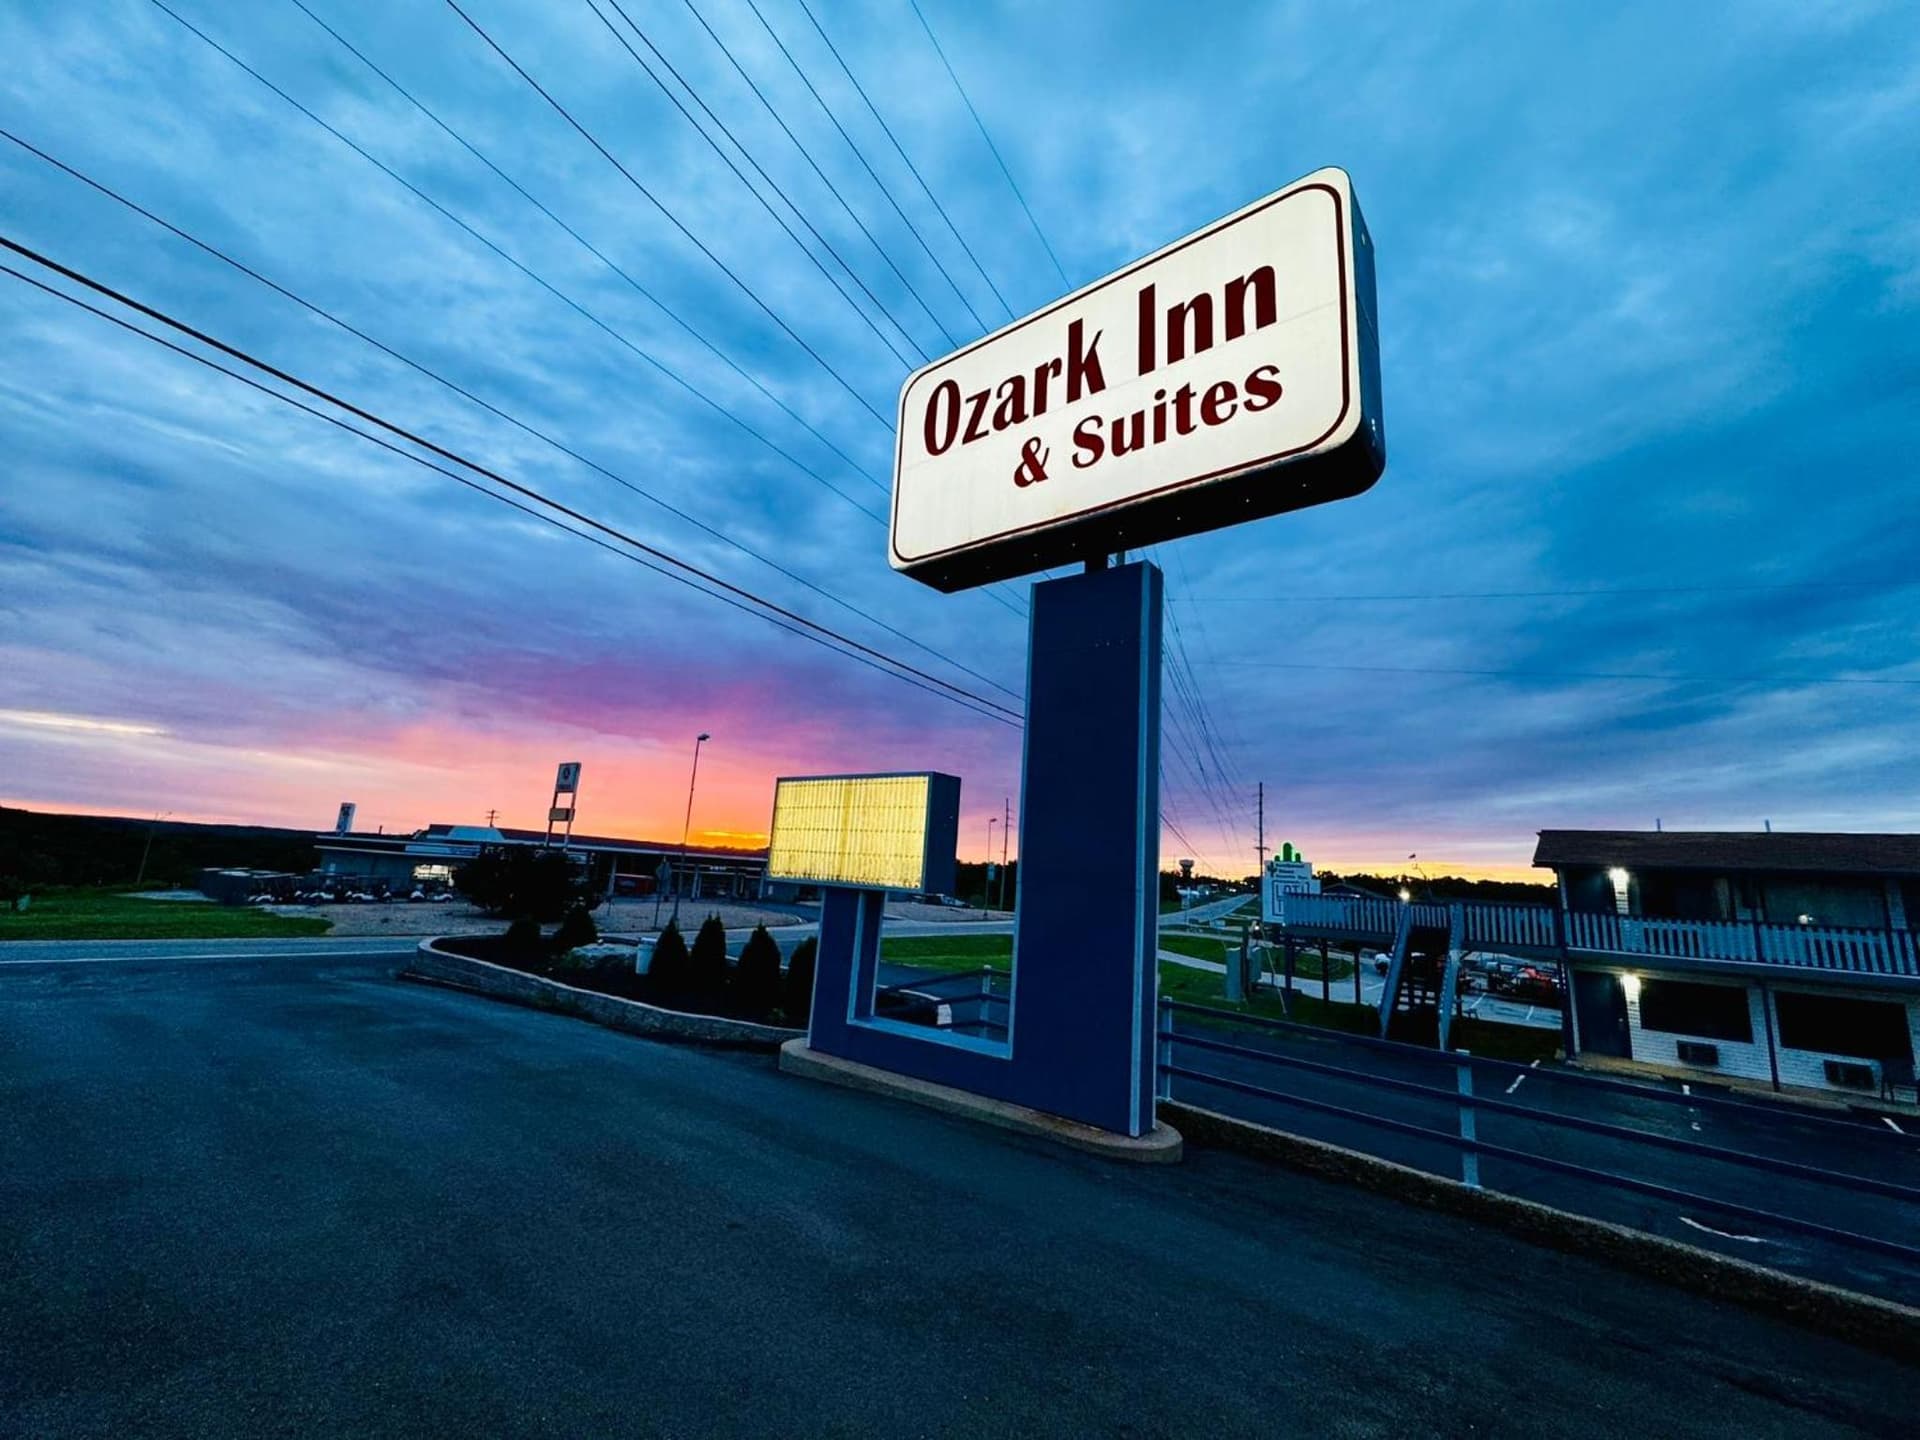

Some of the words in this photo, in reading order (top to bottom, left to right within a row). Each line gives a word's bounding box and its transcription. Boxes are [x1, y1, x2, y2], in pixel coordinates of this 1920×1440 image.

[924, 318, 1106, 457] Ozark
[1138, 265, 1277, 377] Inn
[1013, 436, 1048, 488] &
[1072, 364, 1283, 469] Suites
